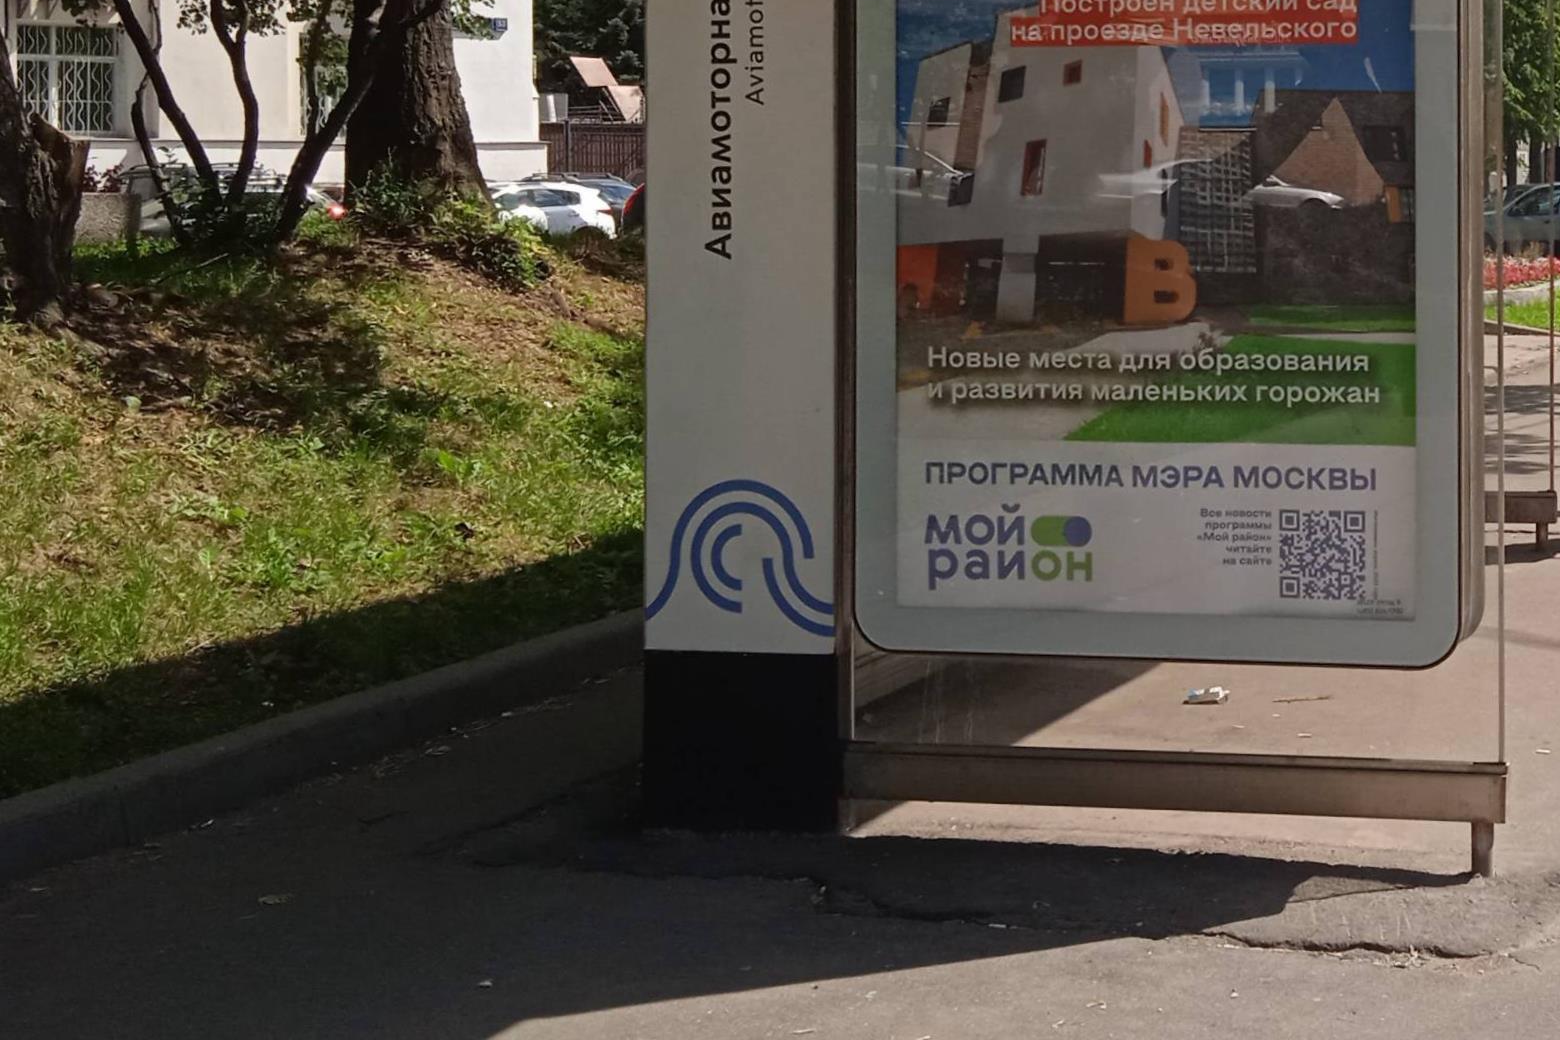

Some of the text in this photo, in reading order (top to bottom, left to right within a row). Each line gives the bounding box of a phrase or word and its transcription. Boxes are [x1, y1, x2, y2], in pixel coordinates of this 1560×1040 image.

[1011, 18, 1357, 45] на проезде Невельского
[927, 346, 1370, 377] Новые места для образования
[927, 382, 1381, 408] и развития маленьких горожан
[924, 461, 1377, 491] ПРОГРАММА МЭРА МОСКВЫ
[1204, 520, 1272, 531] программы
